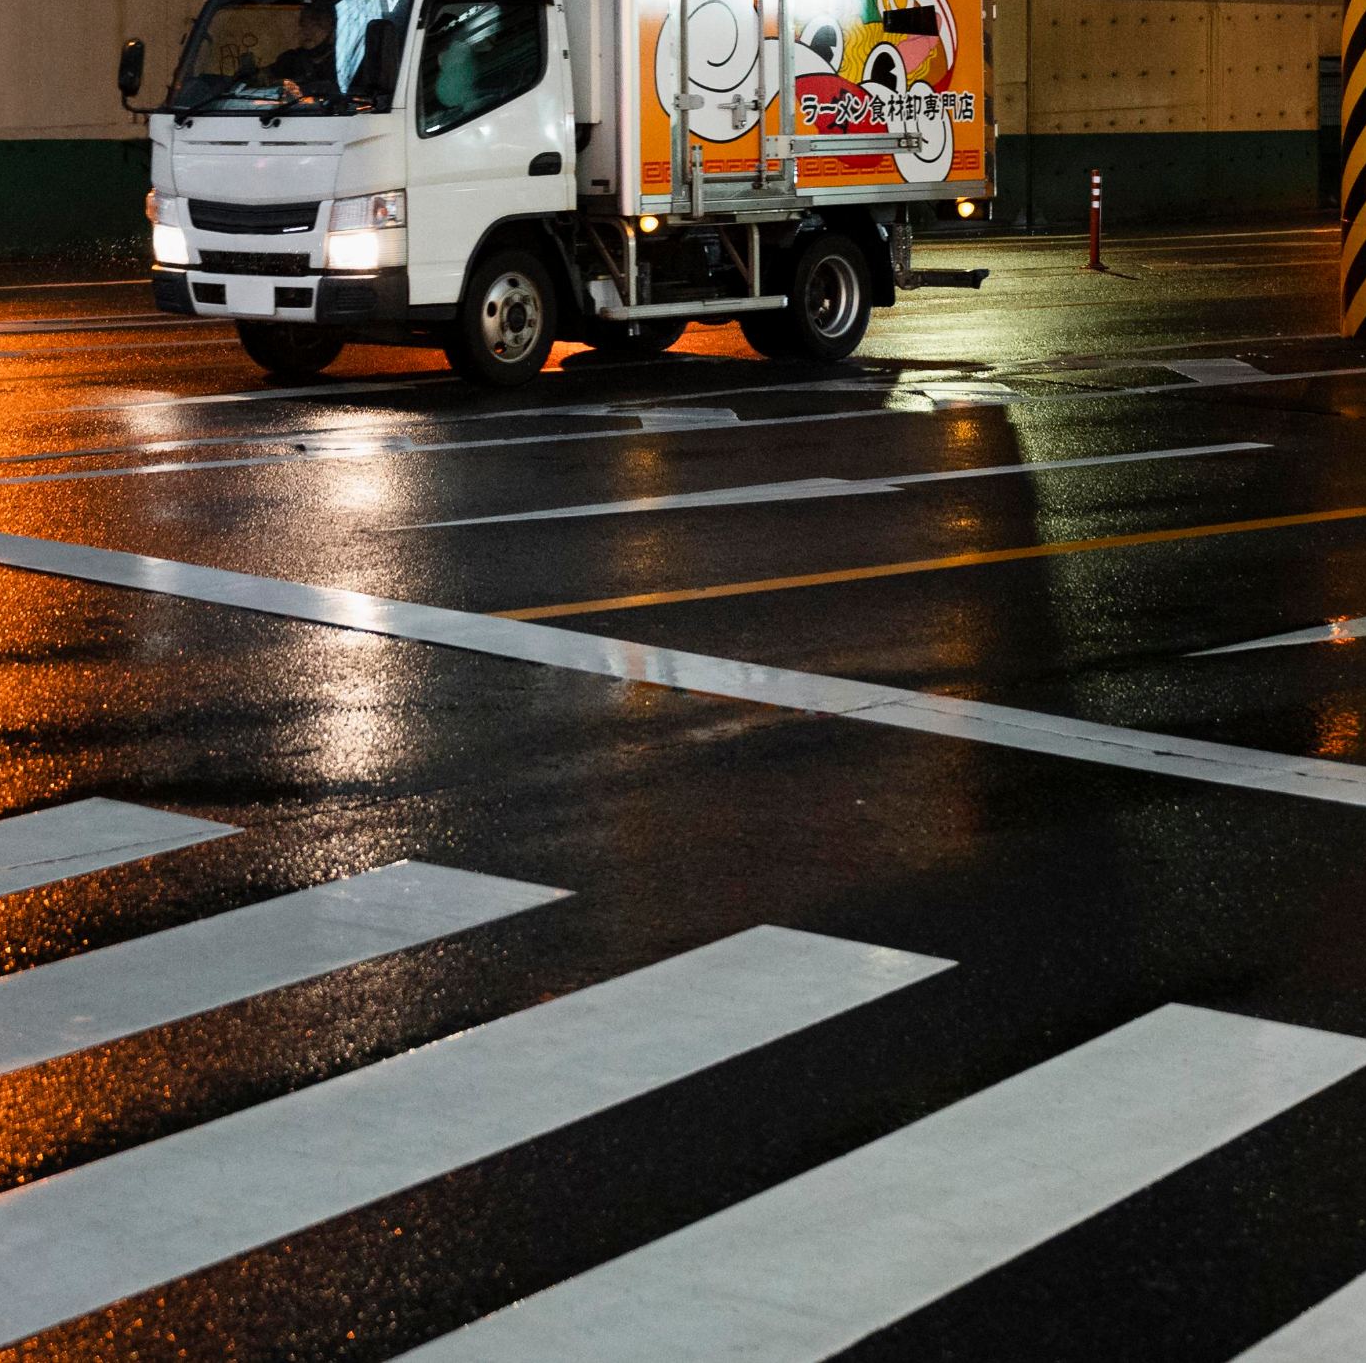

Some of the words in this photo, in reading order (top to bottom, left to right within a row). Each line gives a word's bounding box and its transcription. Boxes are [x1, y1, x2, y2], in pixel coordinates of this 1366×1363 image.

[800, 92, 975, 126] ラーメン食材卸専門店
